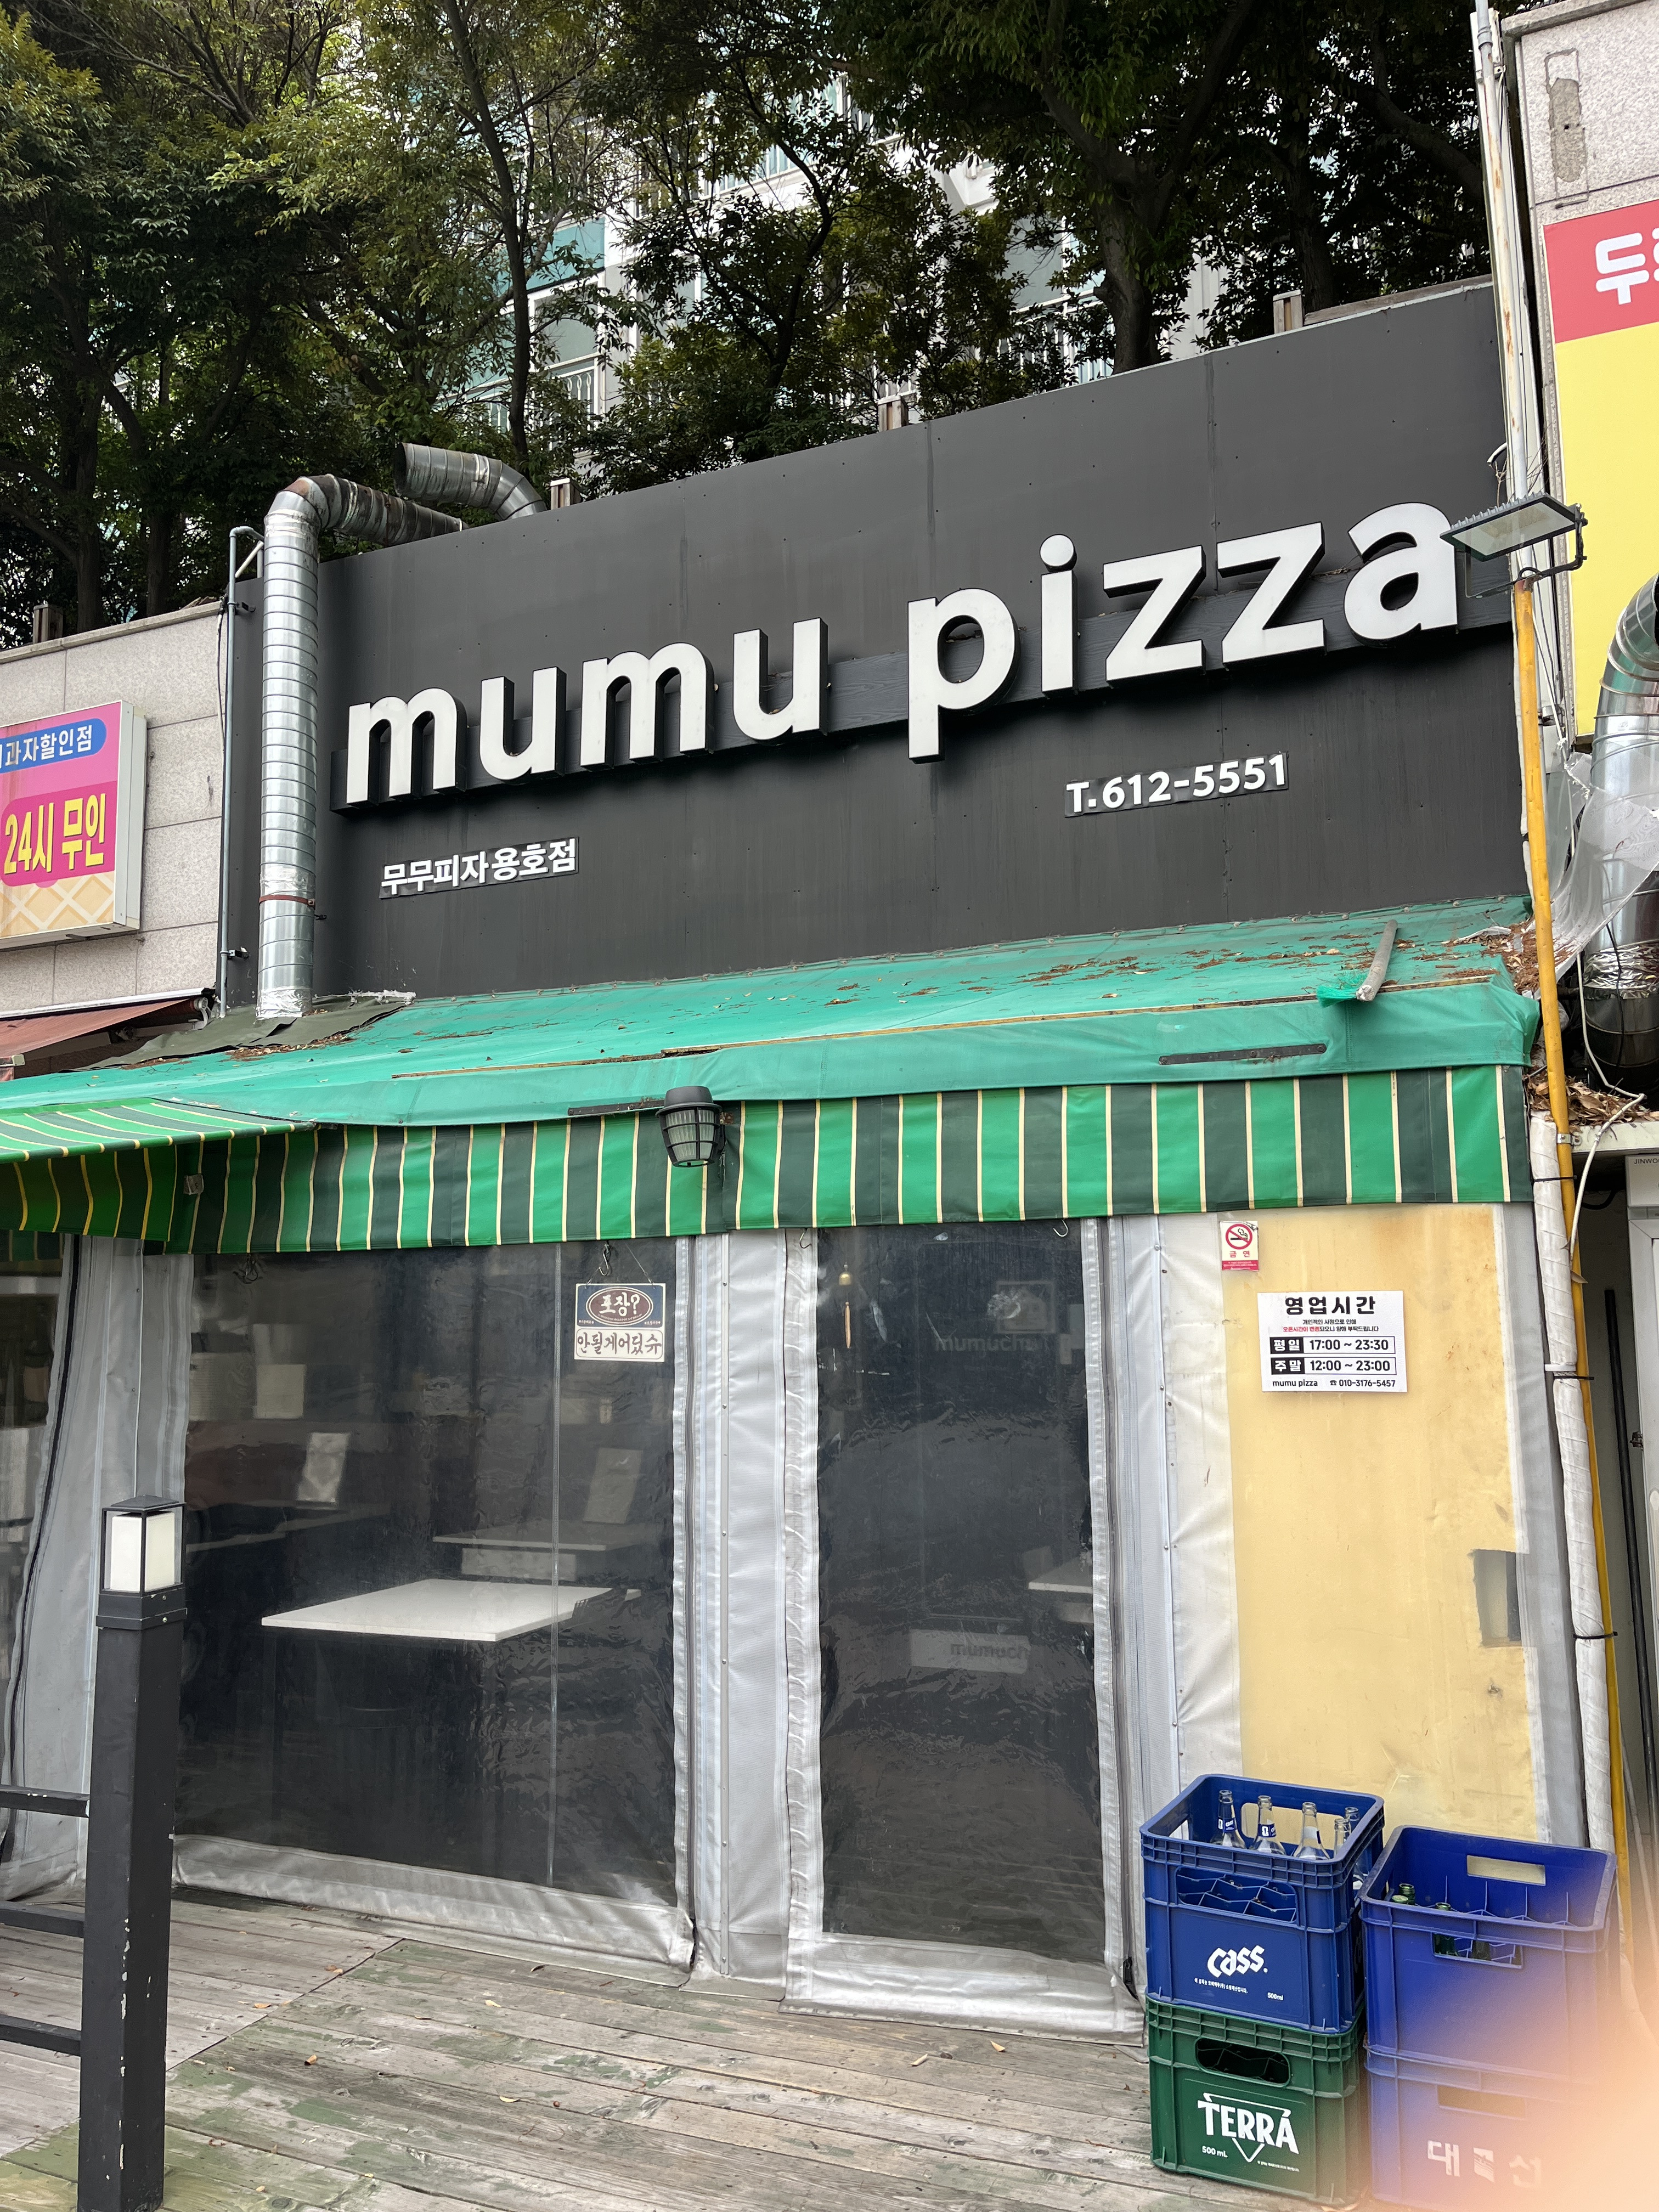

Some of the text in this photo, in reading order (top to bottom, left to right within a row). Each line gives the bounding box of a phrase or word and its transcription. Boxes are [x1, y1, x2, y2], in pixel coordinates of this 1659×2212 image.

[346, 501, 1458, 805] mumu pizza
[0, 724, 93, 768] 과자할인점
[1066, 753, 1285, 813] T.612-5551
[4, 793, 106, 876] 24시 무인
[599, 1291, 640, 1317] 포장?
[1284, 1296, 1376, 1316] 영업시간
[1273, 1339, 1301, 1352] 평일
[1309, 1339, 1341, 1351] 17:00
[1355, 1339, 1389, 1351] 23:30
[1274, 1359, 1301, 1373] 주말
[1310, 1360, 1341, 1372] 12:00
[1356, 1359, 1391, 1372] 23:00
[1298, 1379, 1318, 1389] pizza
[1339, 1379, 1396, 1387] 010-3176-5457
[1267, 1992, 1284, 2001] 500ml
[1197, 2100, 1300, 2155] TERRA
